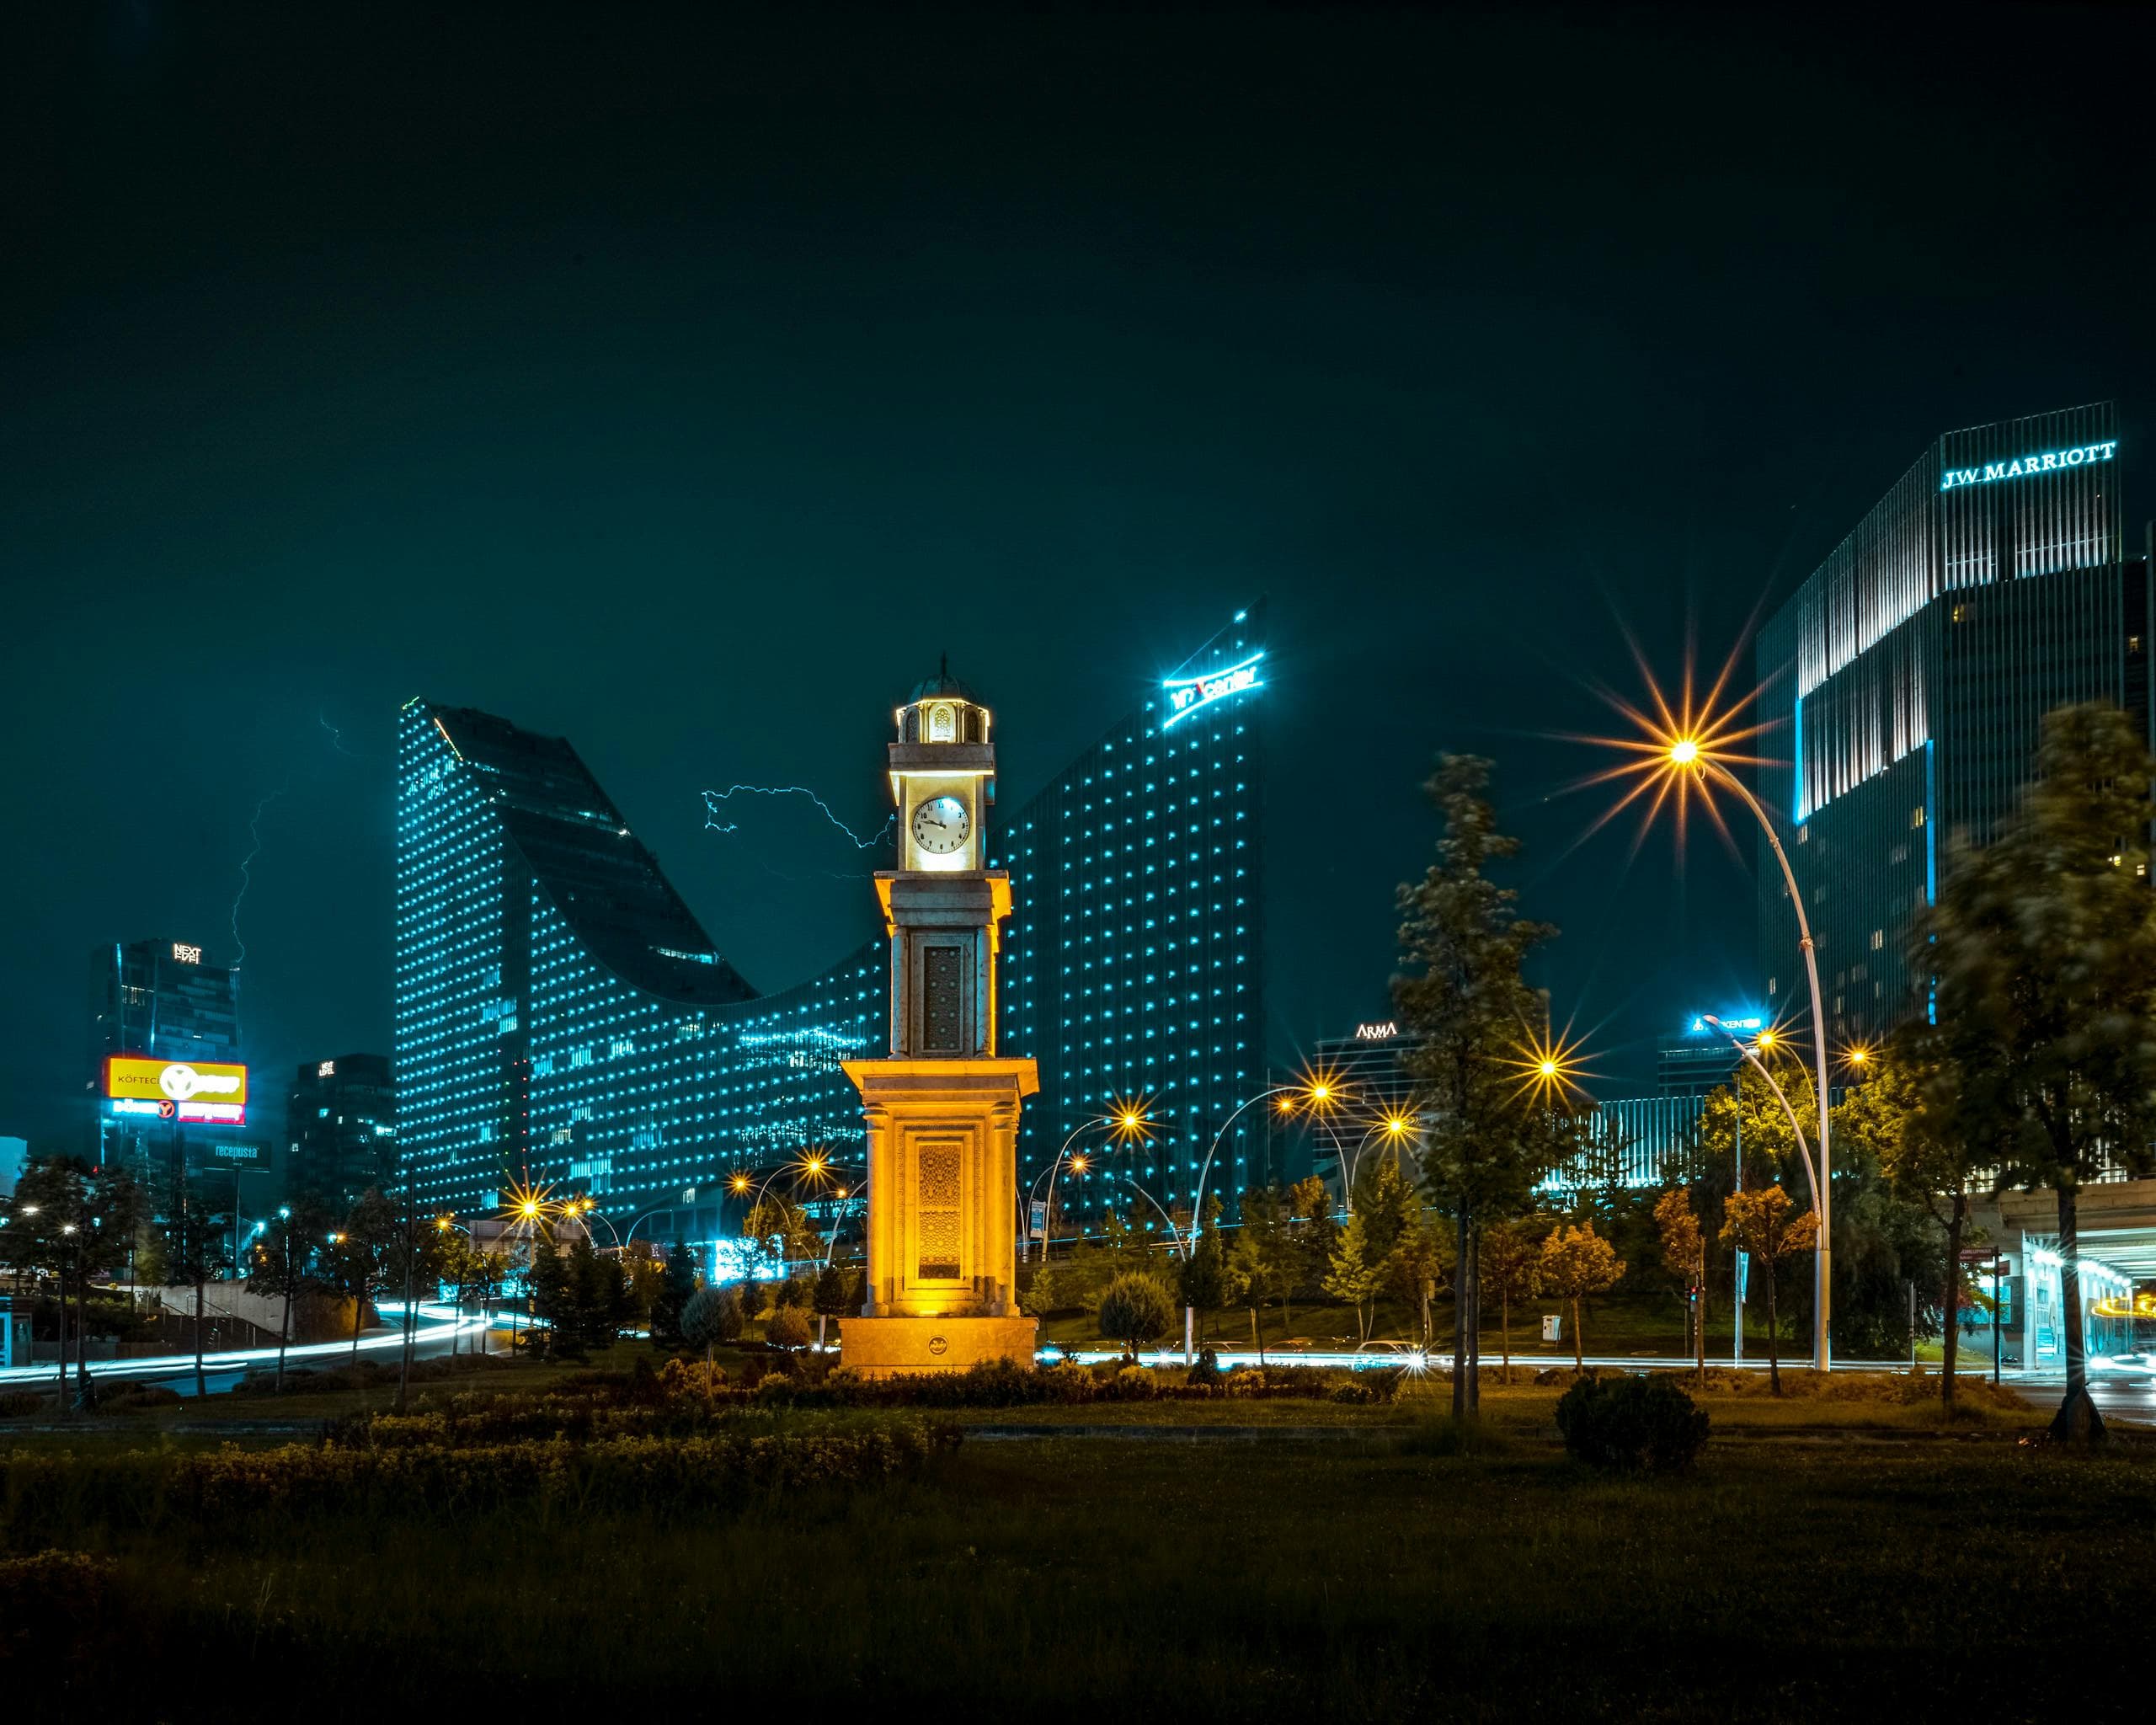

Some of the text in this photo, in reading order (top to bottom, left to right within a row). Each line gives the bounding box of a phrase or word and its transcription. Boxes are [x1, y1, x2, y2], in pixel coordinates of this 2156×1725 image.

[1942, 441, 2116, 489] JW MARRIOTT
[174, 943, 202, 957] NEXT
[1356, 1022, 1397, 1039] ARMA
